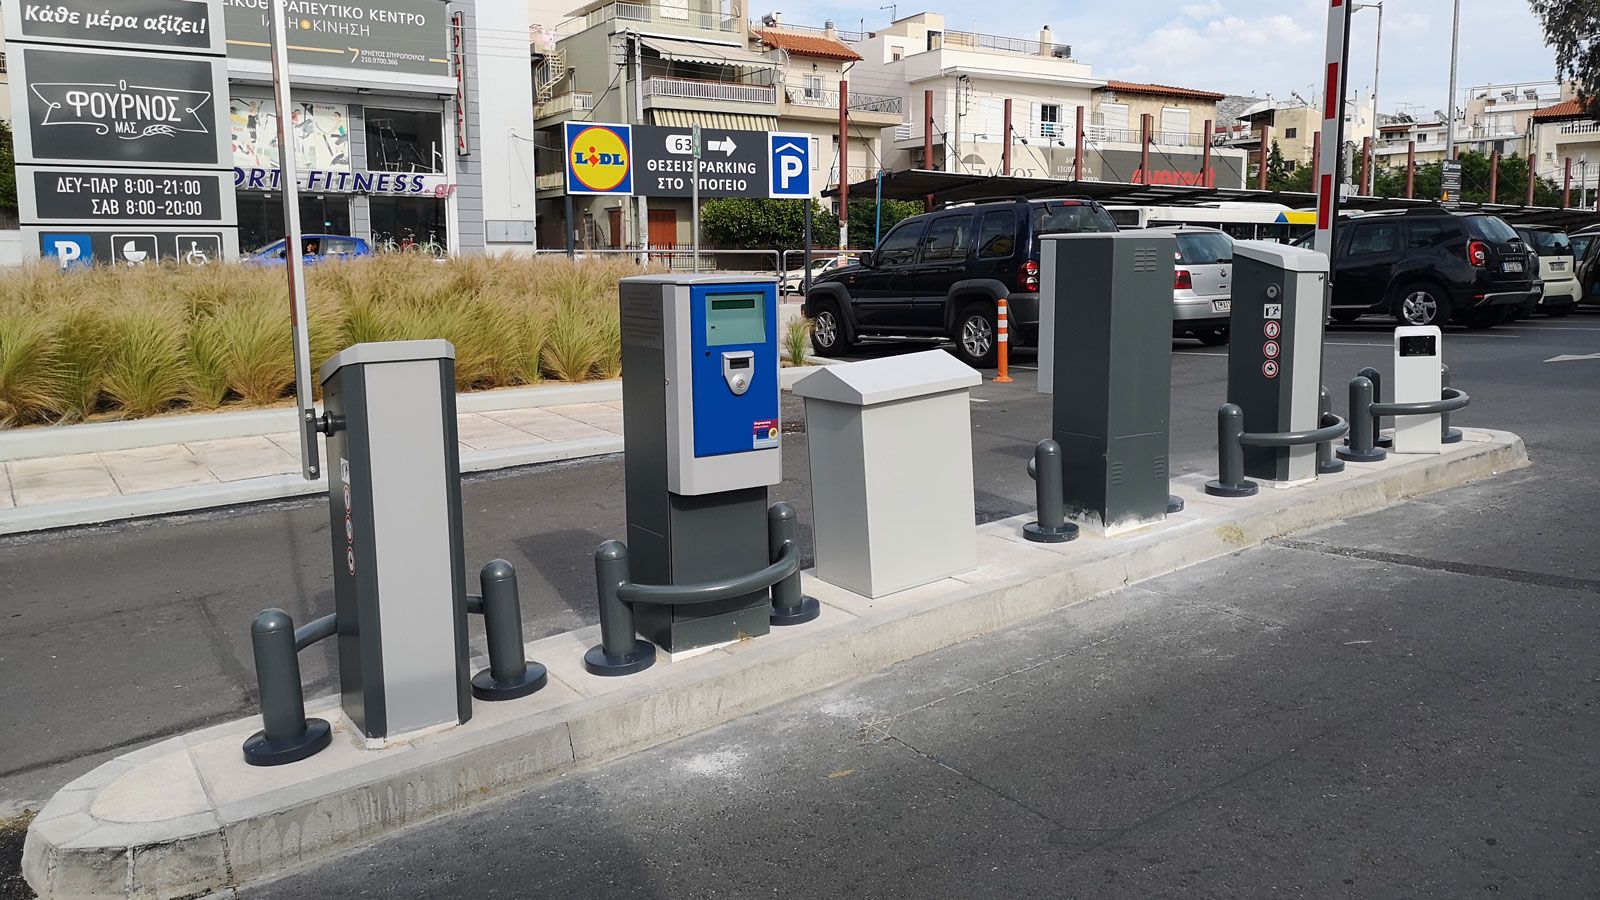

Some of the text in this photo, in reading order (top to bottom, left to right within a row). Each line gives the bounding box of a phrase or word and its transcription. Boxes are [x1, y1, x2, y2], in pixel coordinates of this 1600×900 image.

[25, 5, 206, 36] Κάθε μέρα αξίζει!
[369, 10, 426, 26] ΚΕΝΤΡΟ
[313, 19, 370, 37] ΚΙΝΗΣΗ
[66, 90, 182, 122] ΦΟΥΡΝΟΣ
[115, 121, 137, 134] ΜΑΣ
[675, 138, 692, 151] 63
[646, 159, 757, 174] ΘΕΣΕΙΣ PARKING
[781, 155, 803, 189] P
[56, 177, 201, 195] ΔΕΥ-ΠΑΡ 8:00-21:00
[657, 177, 747, 191] ΣΤΟ ΠΟΓΕΙΟ
[92, 199, 202, 216] ΣΑΒ 8:00-20:00
[54, 240, 81, 268] P
